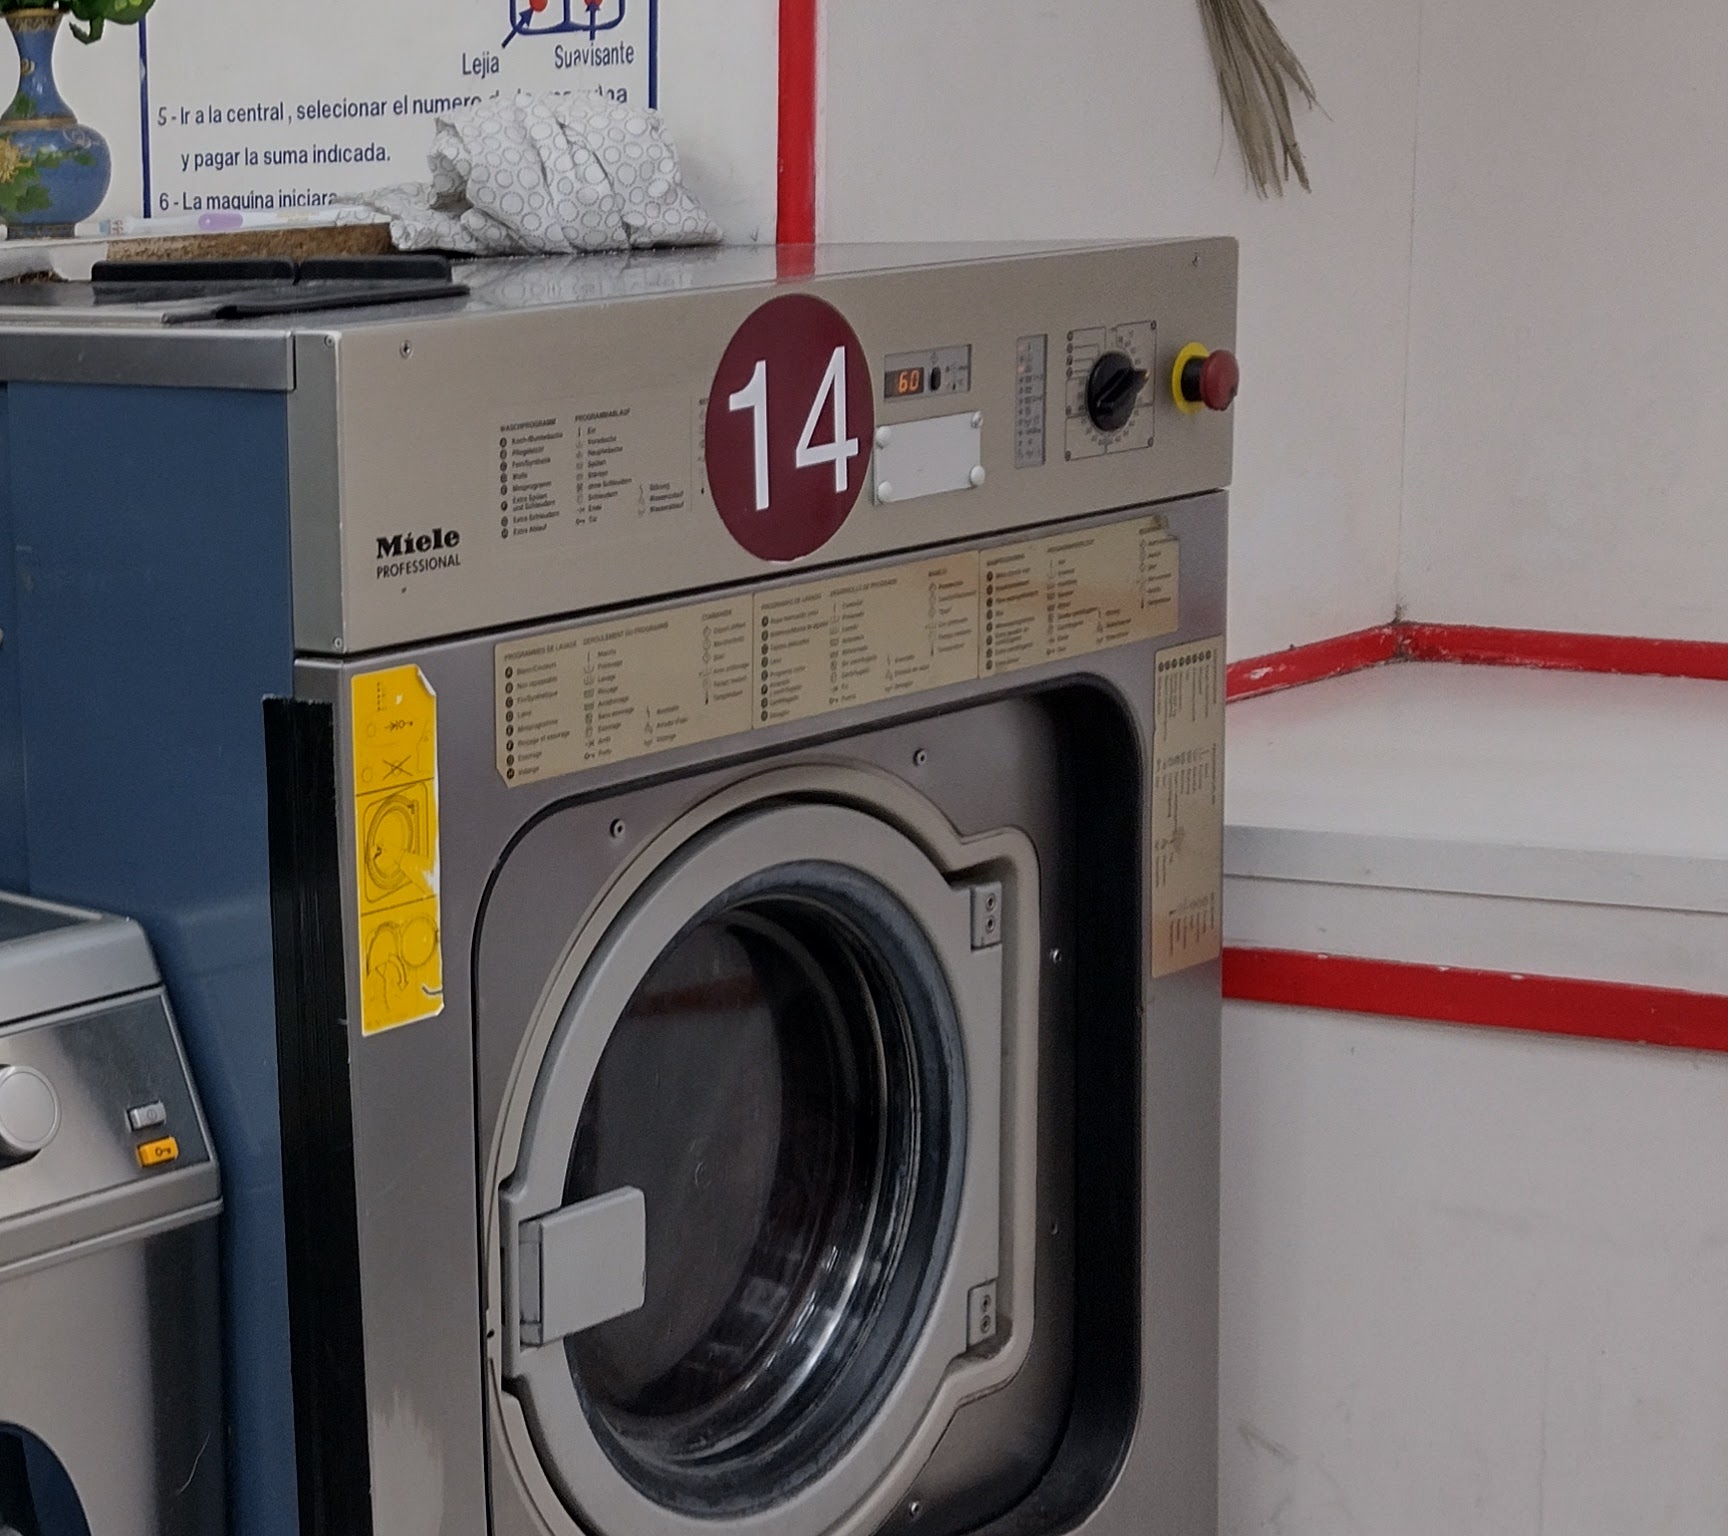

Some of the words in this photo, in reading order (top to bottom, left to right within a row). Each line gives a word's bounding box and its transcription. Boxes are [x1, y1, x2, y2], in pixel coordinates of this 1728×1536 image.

[181, 106, 191, 125] Ir
[195, 110, 204, 125] a
[209, 104, 222, 125] la
[393, 94, 408, 116] el
[181, 153, 190, 173] y
[194, 151, 241, 172] pagar
[245, 147, 258, 166] la
[263, 149, 308, 168] suma
[313, 142, 390, 164] indicada.
[183, 191, 202, 213] La
[897, 369, 920, 393] 60
[728, 345, 859, 511] 14
[375, 526, 461, 560] Miele
[376, 553, 462, 580] PROFESSIONAL
